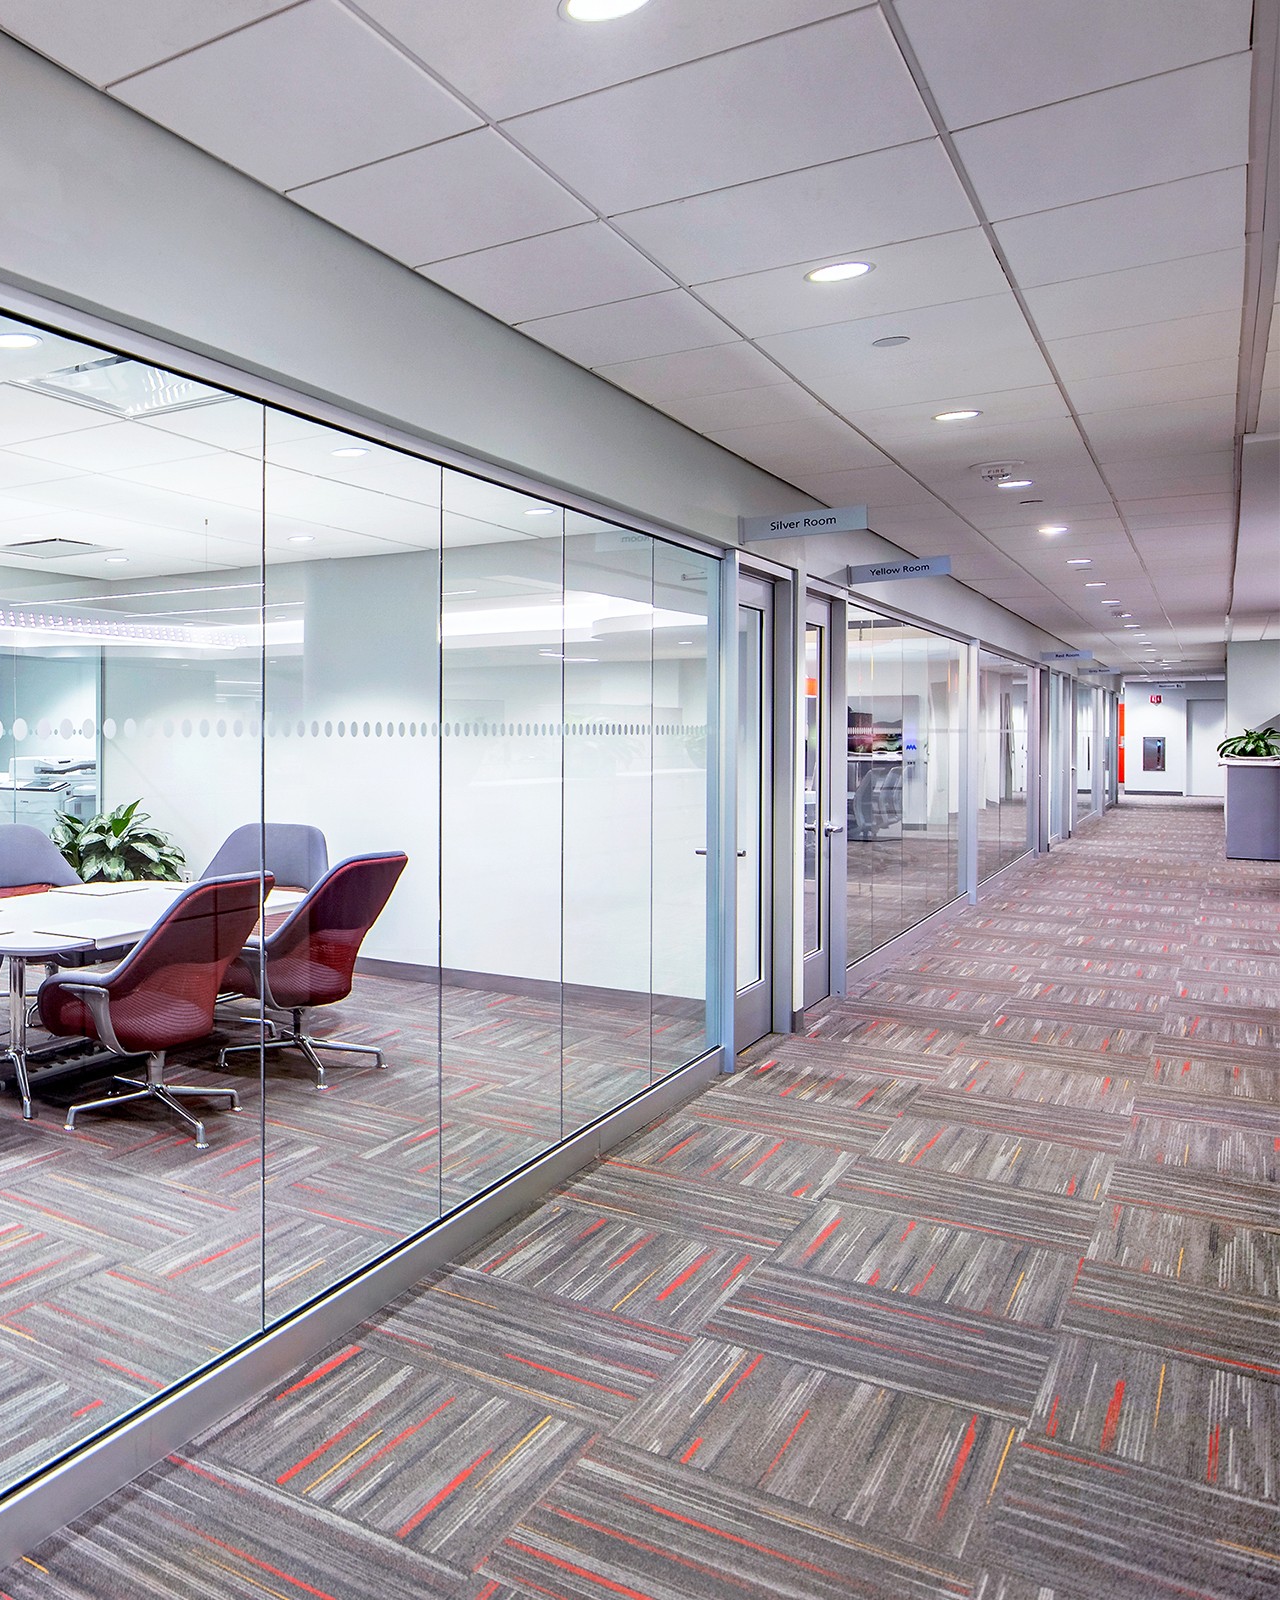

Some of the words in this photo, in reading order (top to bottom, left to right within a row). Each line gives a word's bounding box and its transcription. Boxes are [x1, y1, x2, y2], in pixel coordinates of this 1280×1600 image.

[770, 521, 800, 531] Silver
[803, 517, 837, 527] Room
[869, 567, 901, 577] Yellow
[902, 564, 930, 573] Room
